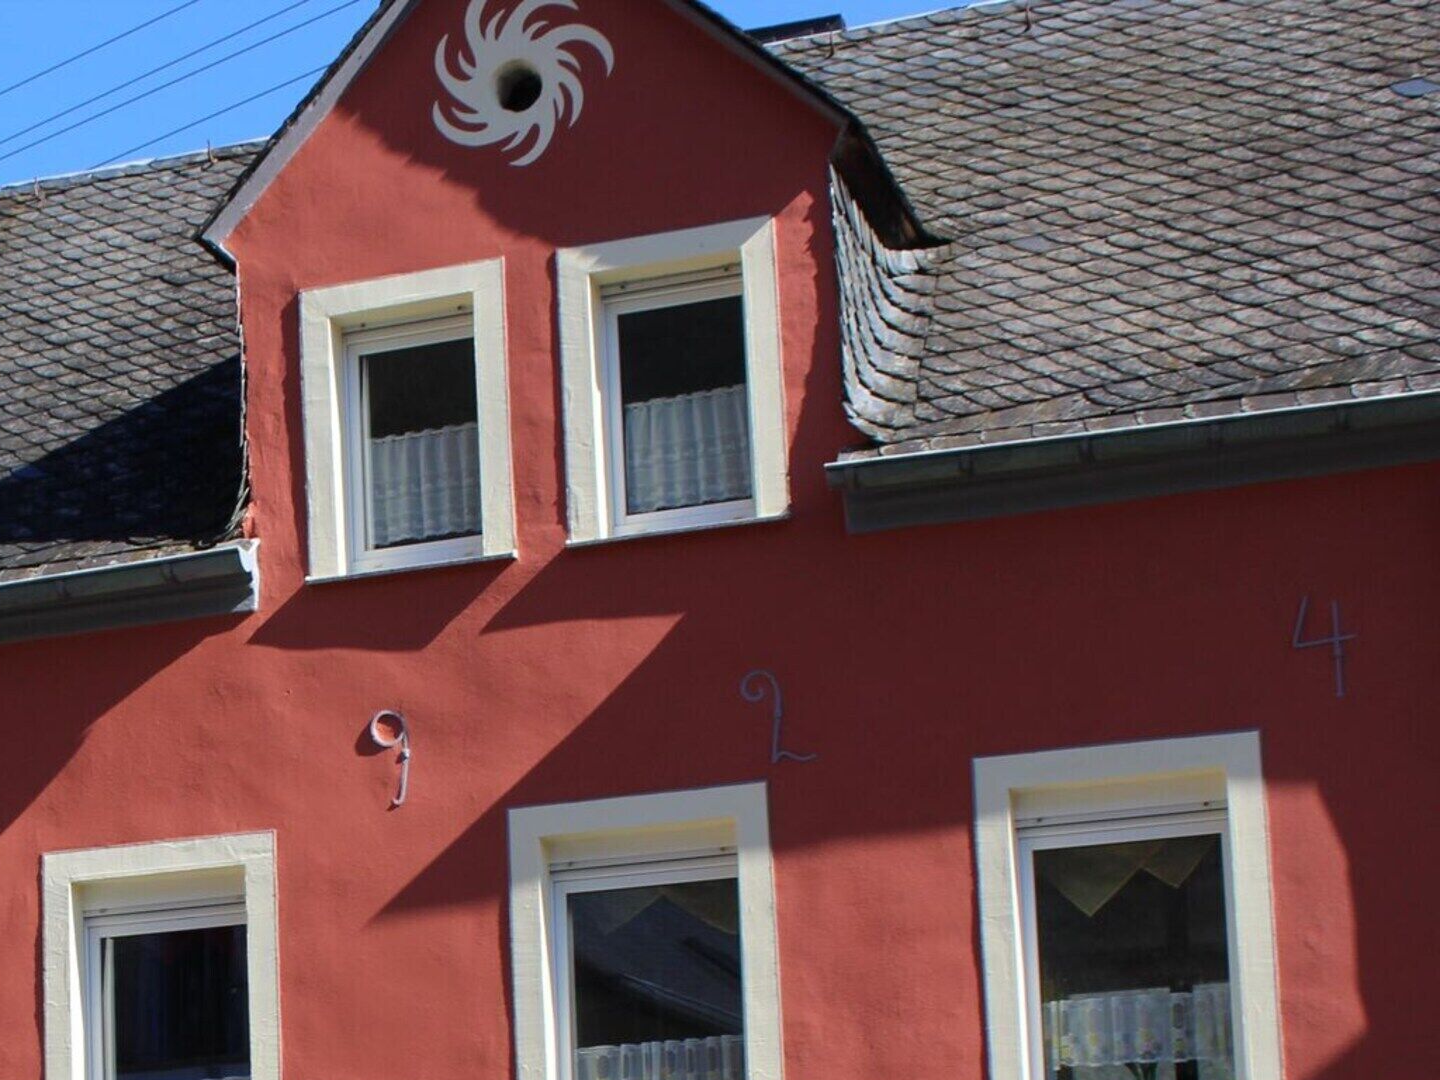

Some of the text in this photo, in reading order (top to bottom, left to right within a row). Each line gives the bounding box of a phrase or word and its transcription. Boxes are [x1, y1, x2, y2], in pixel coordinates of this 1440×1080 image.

[370, 709, 410, 805] 9
[740, 668, 817, 764] 2
[1292, 595, 1359, 698] 4
